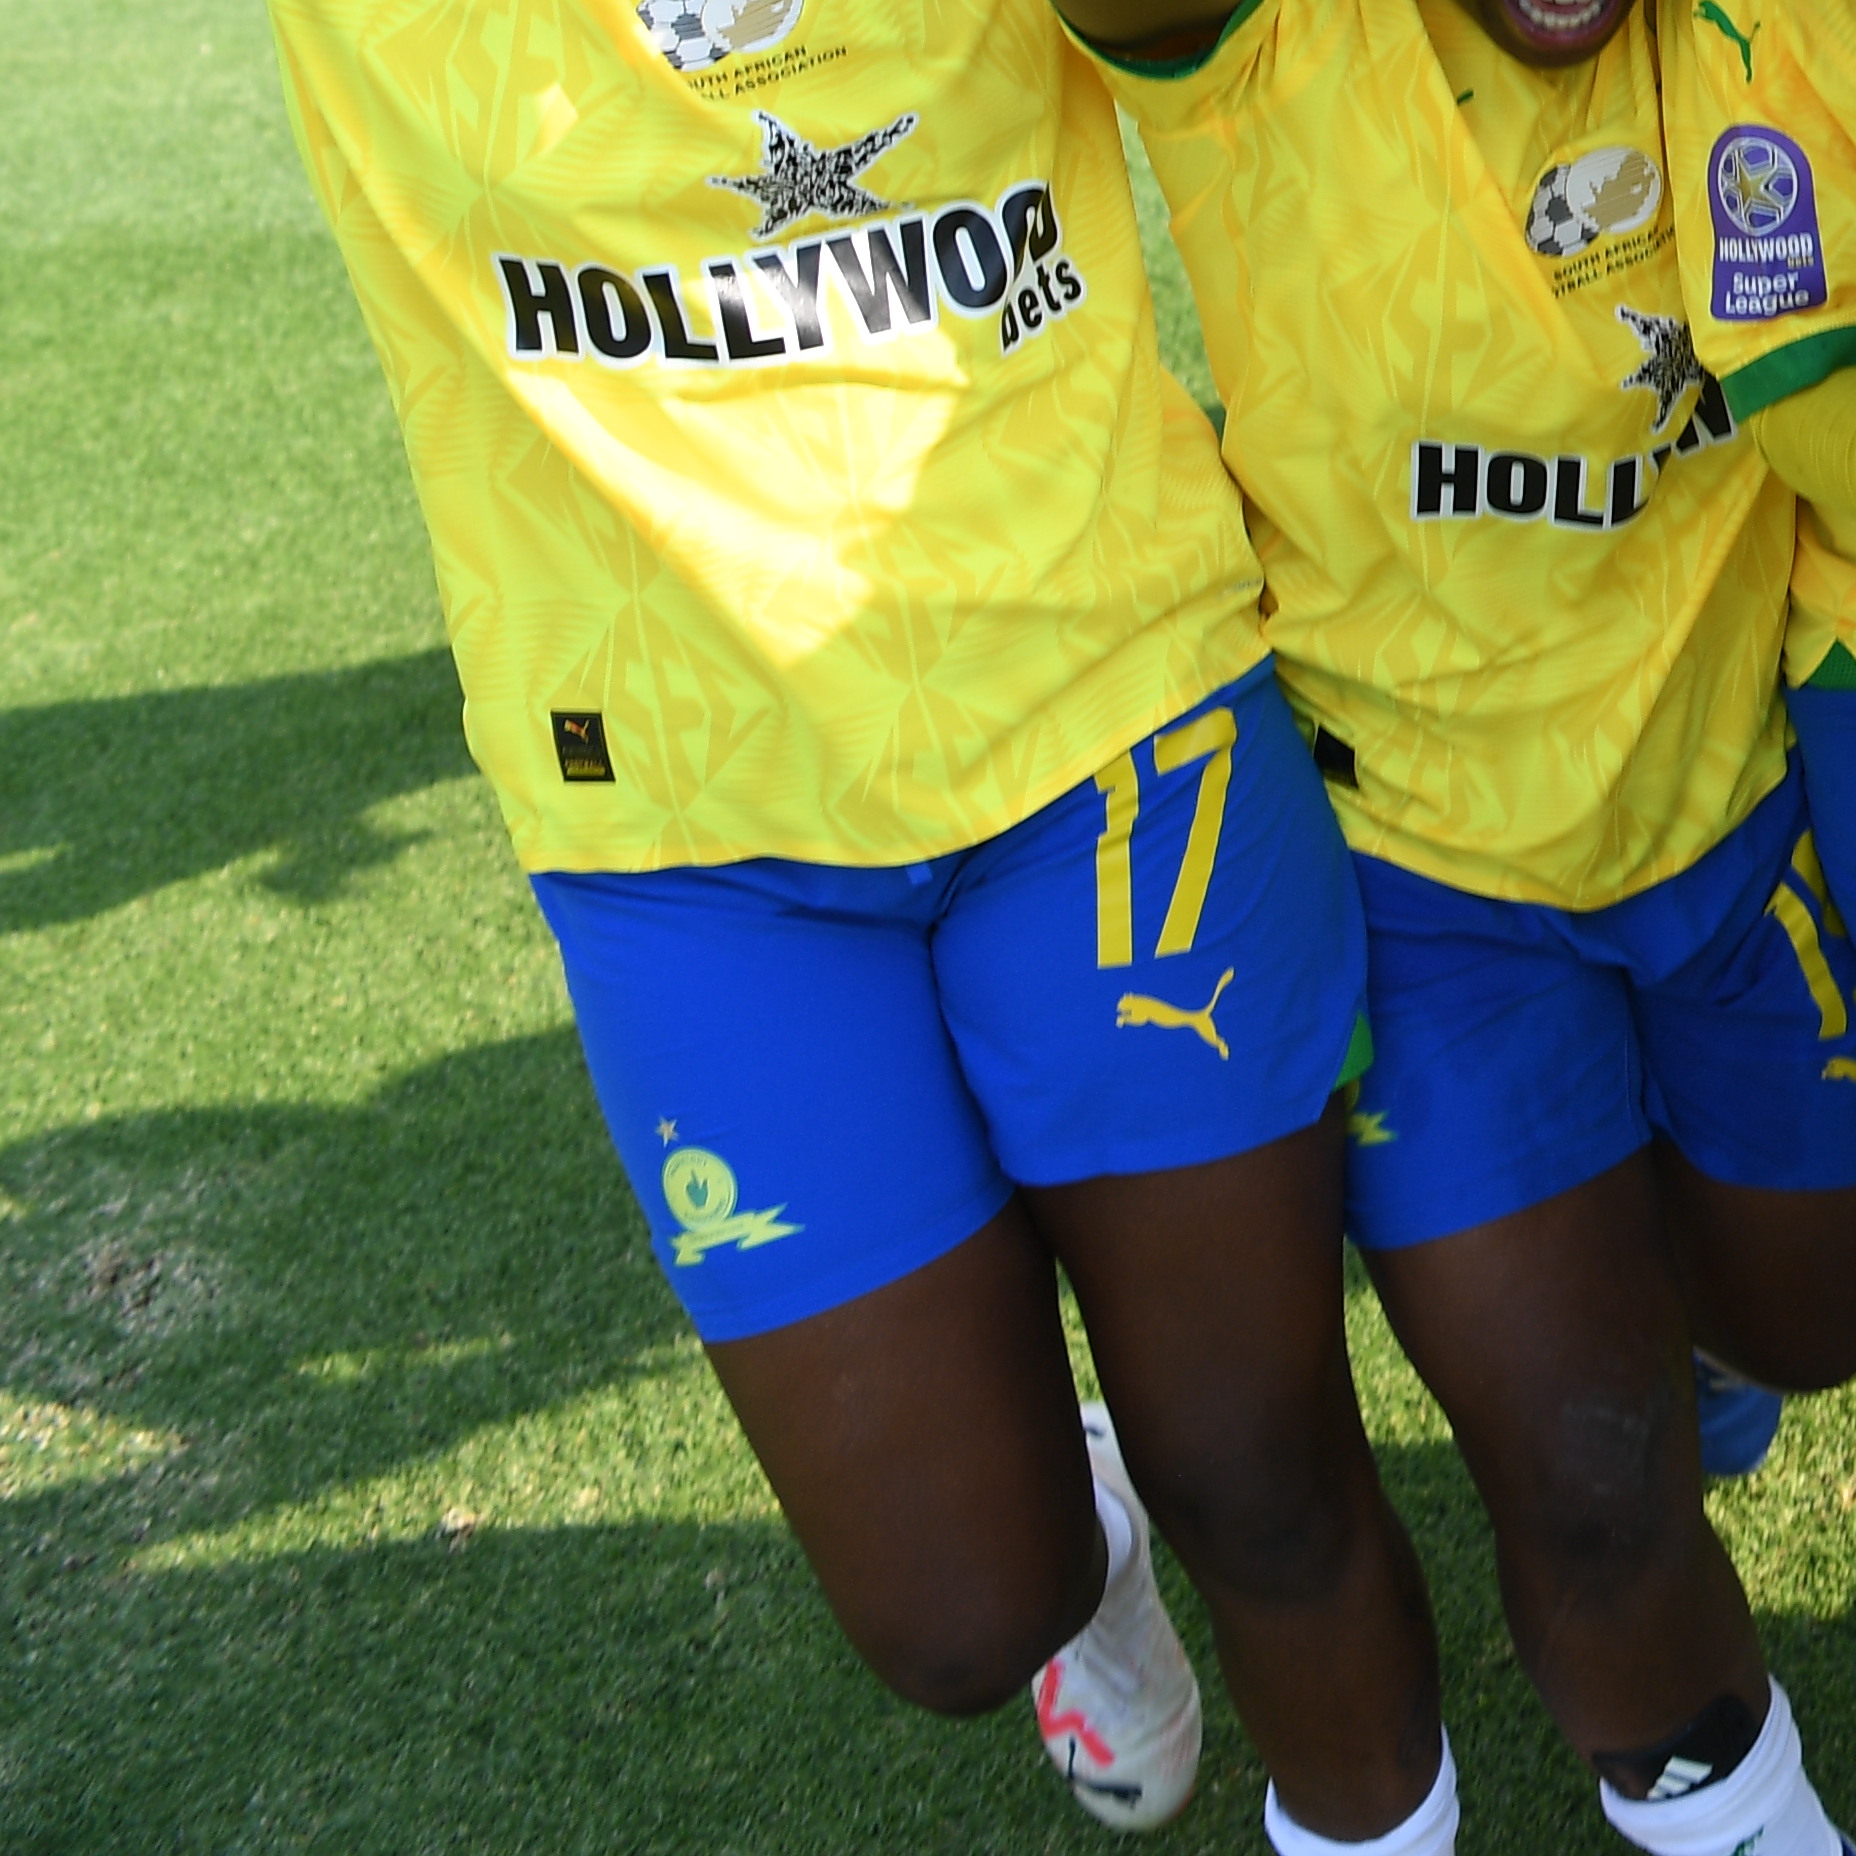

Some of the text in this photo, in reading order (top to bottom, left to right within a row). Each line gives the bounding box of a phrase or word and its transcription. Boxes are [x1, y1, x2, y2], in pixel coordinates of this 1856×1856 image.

[734, 45, 807, 79] AFRICAN
[735, 46, 847, 96] ASSOCIATION
[1720, 232, 1814, 263] HOLLYWOOD
[1733, 271, 1798, 298] Super
[1726, 289, 1809, 316] League
[1094, 706, 1237, 969] 17
